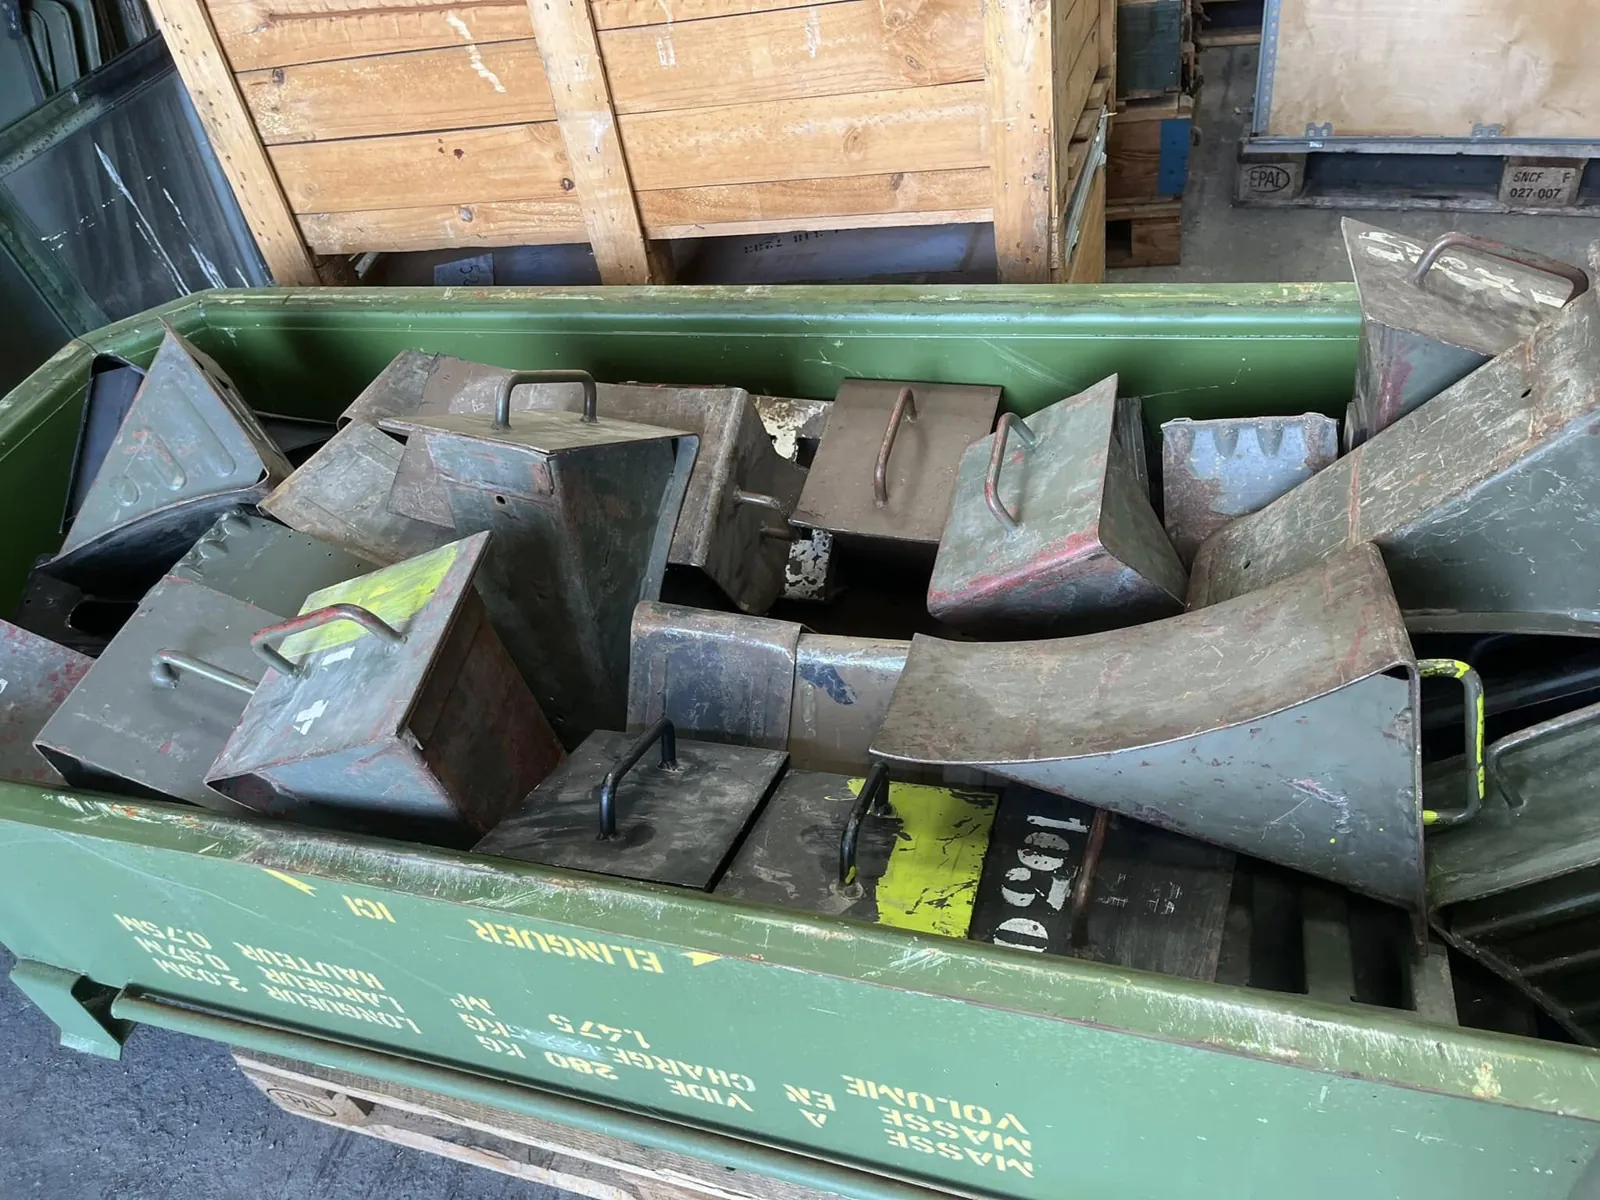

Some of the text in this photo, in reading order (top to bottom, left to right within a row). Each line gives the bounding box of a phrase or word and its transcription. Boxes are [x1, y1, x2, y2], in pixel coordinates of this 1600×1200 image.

[1250, 170, 1281, 188] EPAL
[1513, 171, 1570, 183] SNCF F
[112, 913, 386, 991] HAUTEUR 0.75M
[341, 894, 664, 974] ELINGUER ICI
[152, 957, 423, 1035] LONGUEUR 2.03M
[256, 965, 406, 1014] LARGEUR
[457, 1012, 511, 1038] KG
[547, 1013, 651, 1050] 1.475
[604, 1045, 756, 1093] CHARGE
[475, 1034, 1034, 1179] MASSE A VIDE 280 KG
[782, 1083, 836, 1112] EN
[840, 1074, 1031, 1136] VOLUME
[878, 1105, 1032, 1159] MASSE
